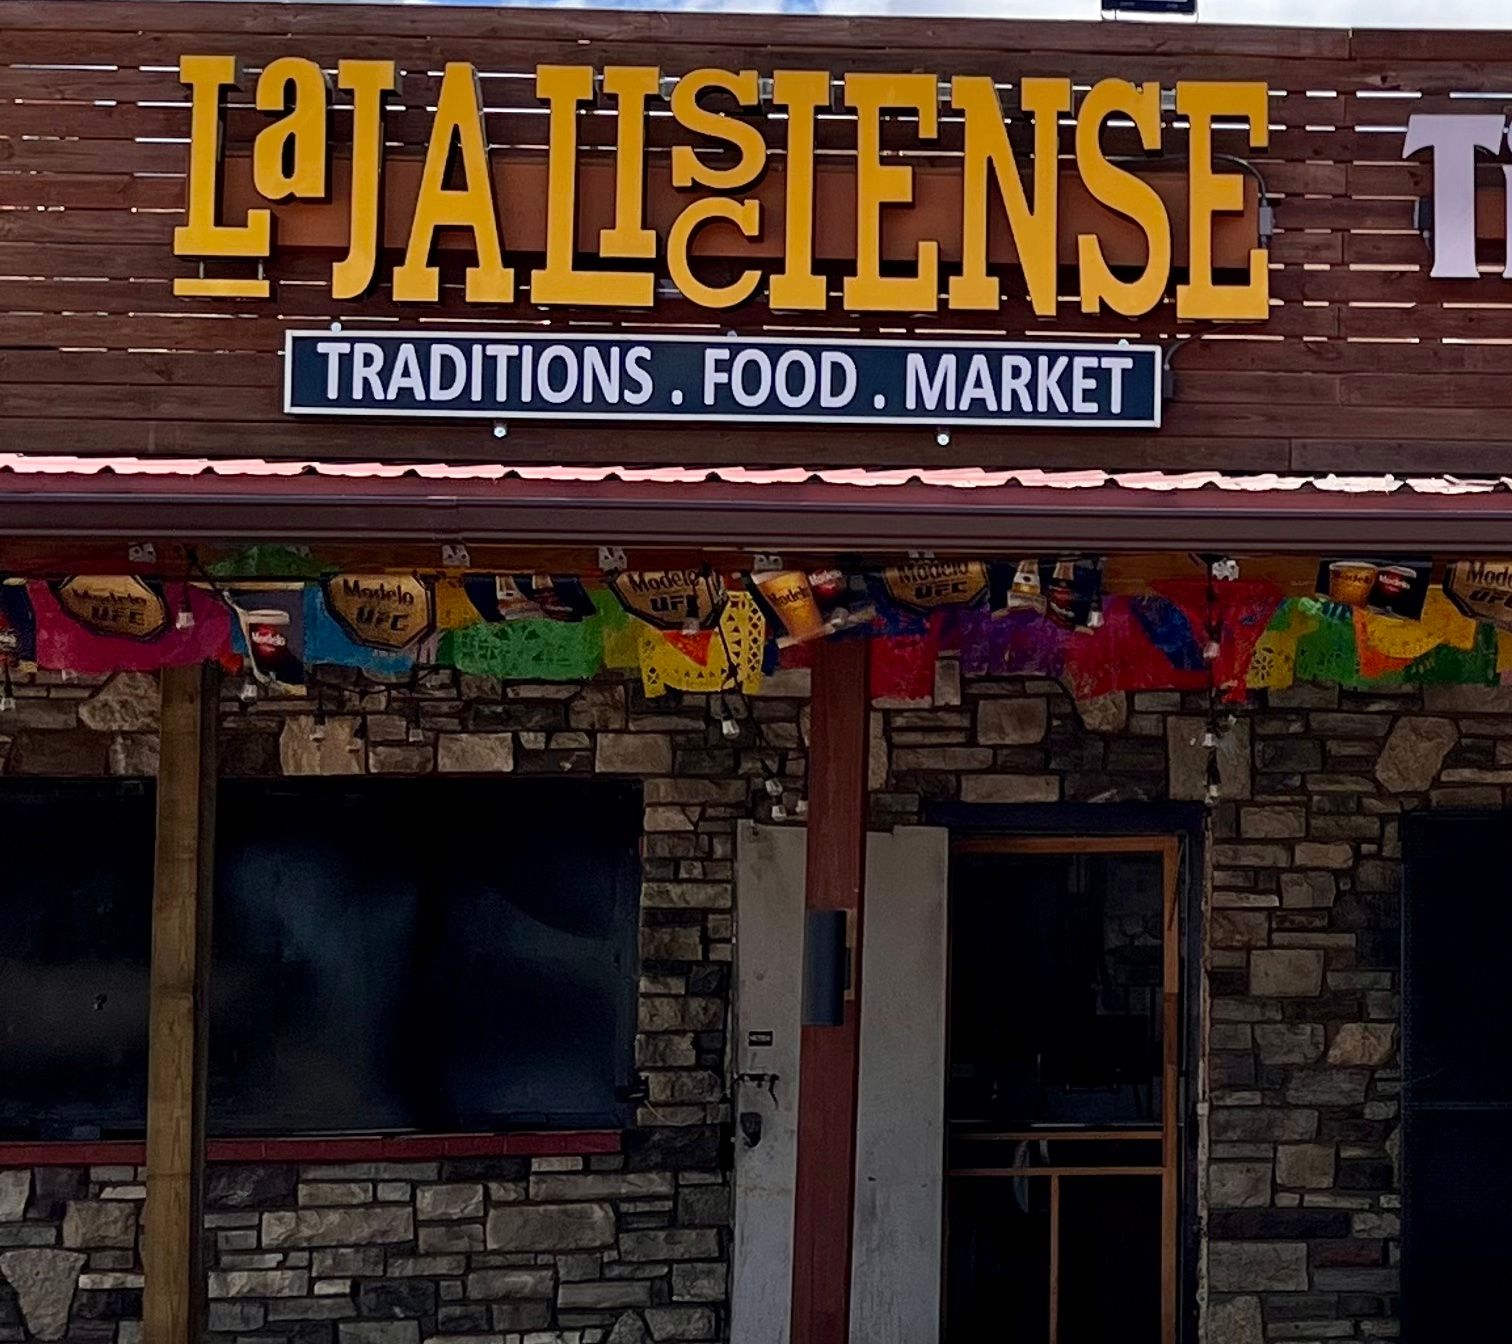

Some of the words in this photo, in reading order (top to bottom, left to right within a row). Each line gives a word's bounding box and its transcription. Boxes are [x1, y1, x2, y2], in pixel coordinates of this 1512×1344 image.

[316, 342, 653, 405] TRADITIONS
[704, 349, 857, 408] FOOD
[906, 354, 1133, 415] MARKET
[343, 578, 414, 605] Modelo
[915, 581, 969, 599] UFC
[356, 606, 409, 632] UFC
